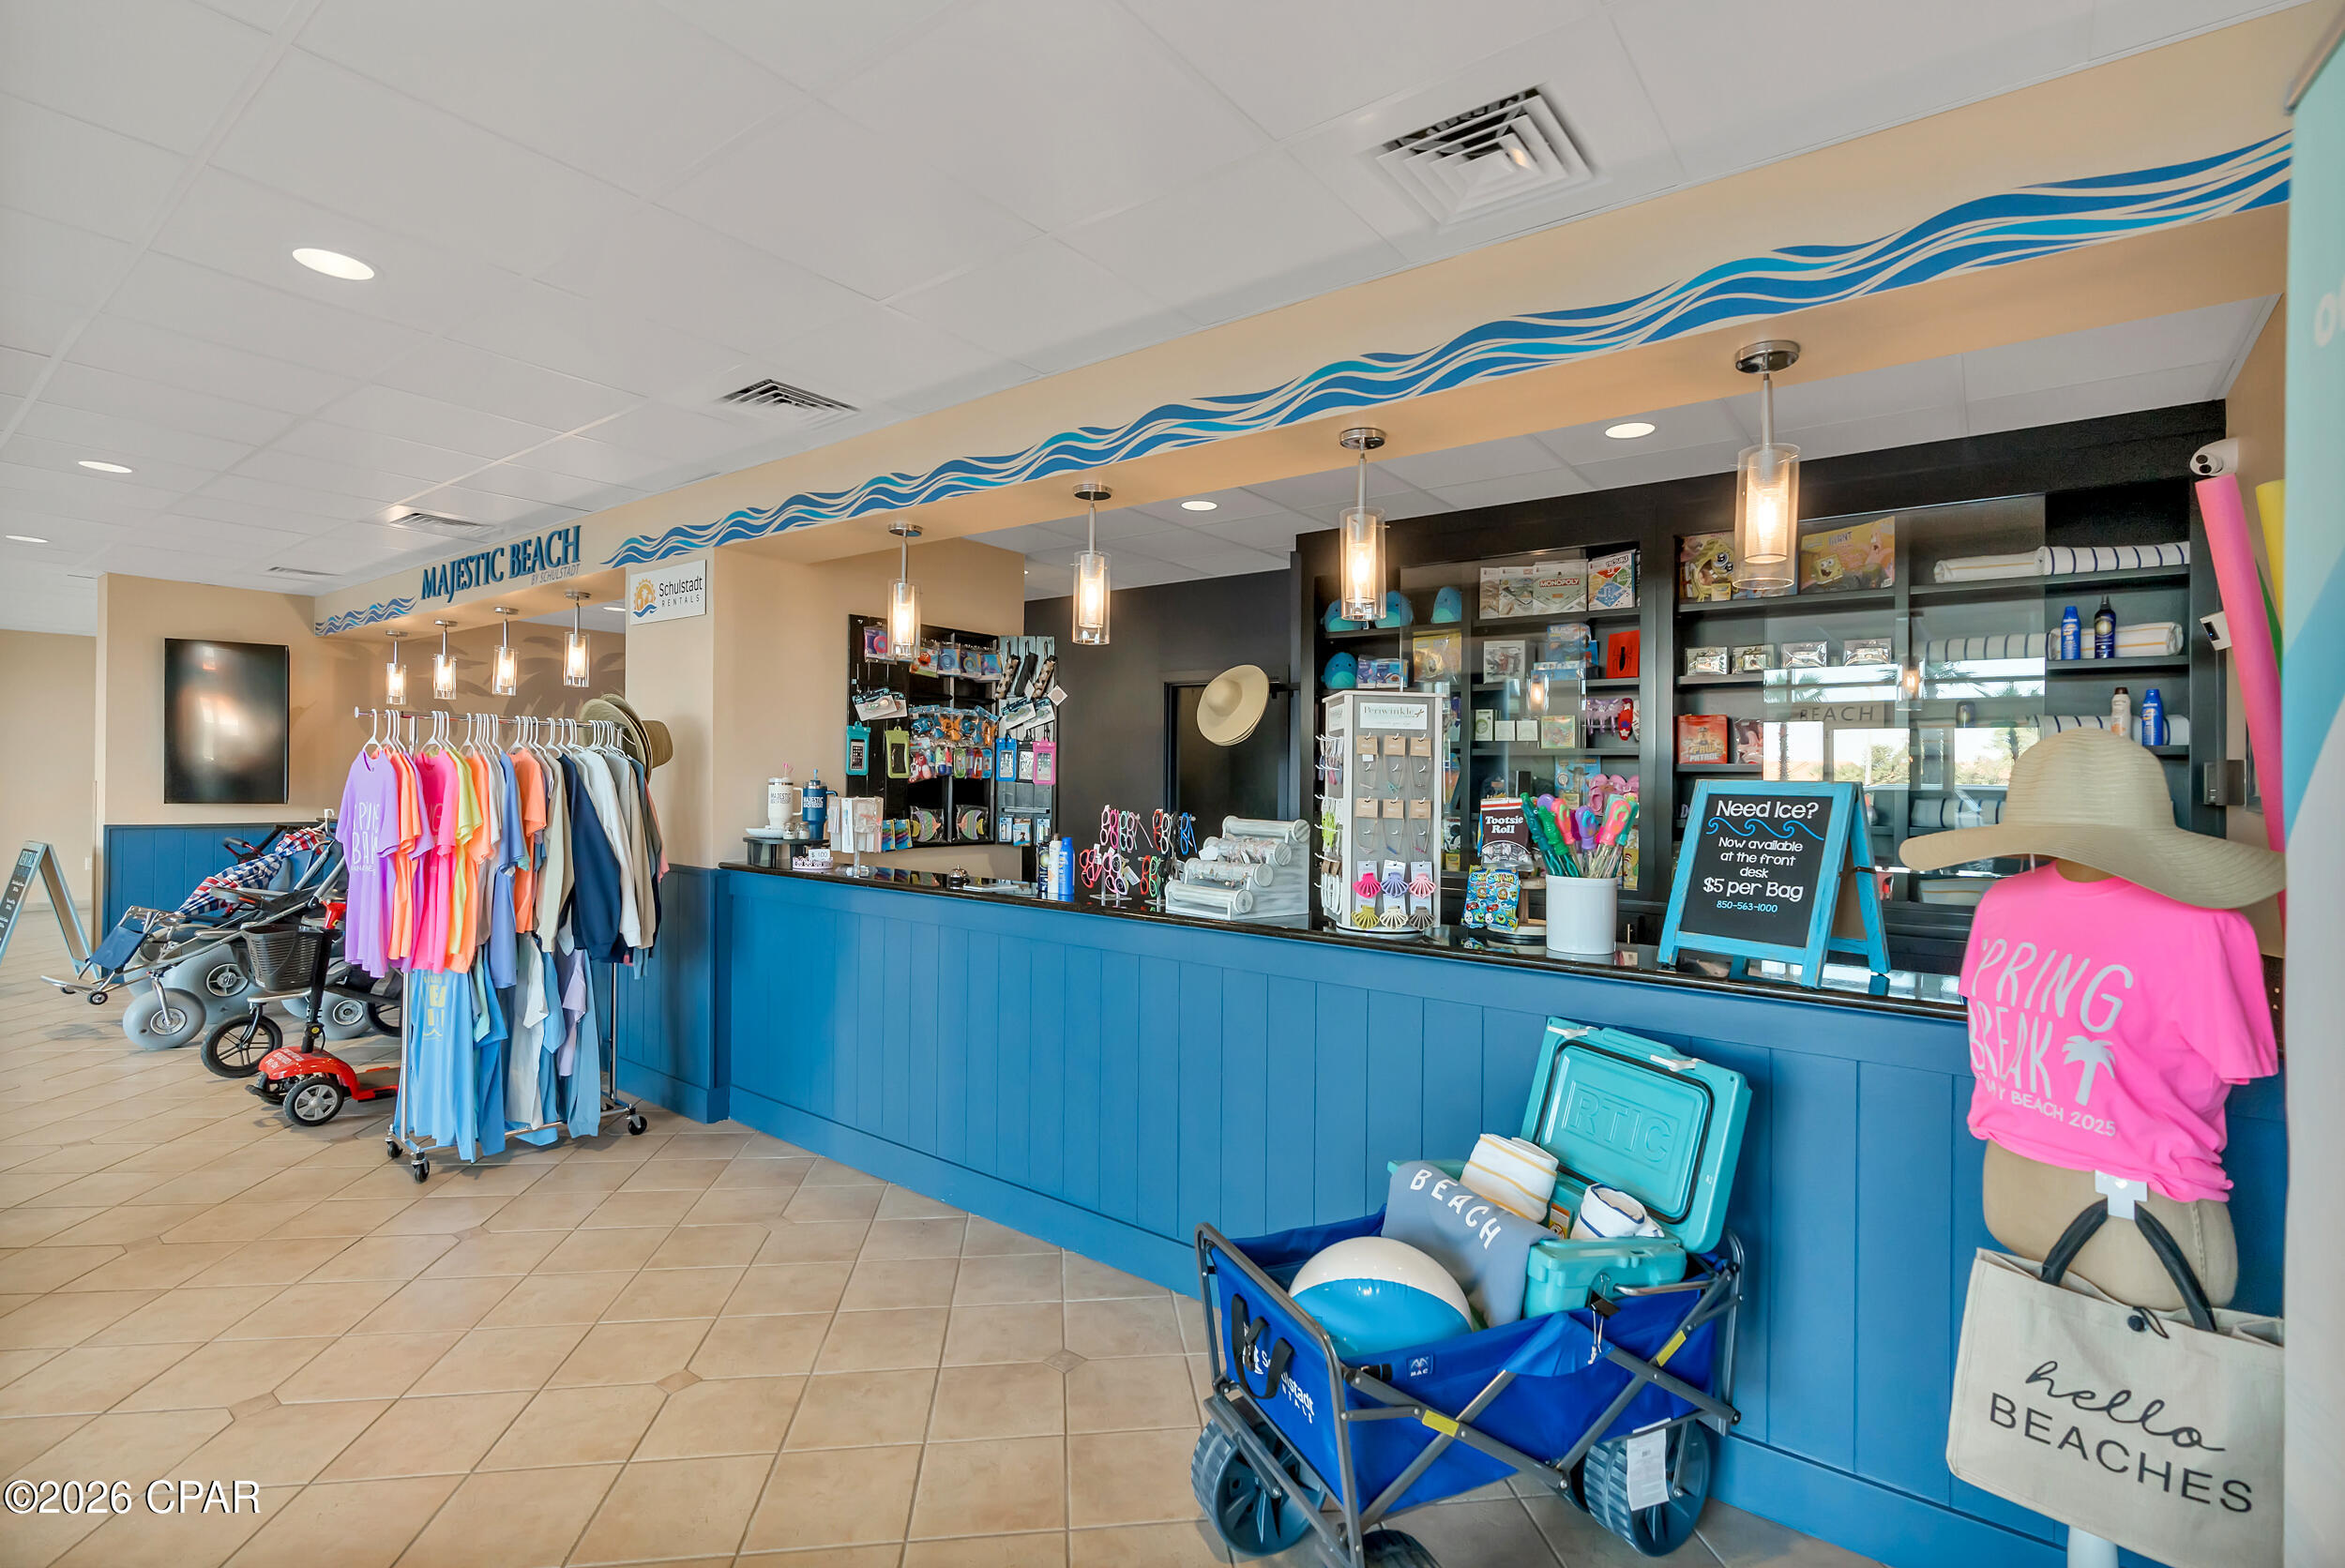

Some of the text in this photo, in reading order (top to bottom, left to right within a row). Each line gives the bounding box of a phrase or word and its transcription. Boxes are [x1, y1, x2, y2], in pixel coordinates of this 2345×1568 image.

[421, 524, 582, 603] MAJESTIC BEACH
[531, 564, 581, 586] BY SCHULSTADT
[1538, 577, 1580, 588] MONOPOLY
[658, 576, 703, 598] Schulstadt
[661, 593, 701, 608] RENTALS
[1485, 815, 1524, 824] Tootsie
[1716, 800, 1819, 820] Need Ice?
[1491, 824, 1516, 834] Roll
[1718, 837, 1803, 852] Now available
[1720, 852, 1796, 867] at the front
[1739, 867, 1769, 879] desk
[1702, 877, 1804, 902] $5 per Bag
[1716, 900, 1778, 913] 850-563-1000
[1972, 938, 2133, 1033] PRING
[2011, 1091, 2116, 1137] BEACH 2025
[1569, 1087, 1672, 1163] RTIC
[1410, 1168, 1501, 1250] BEACH
[1410, 1367, 1429, 1377] MAC
[2025, 1360, 2226, 1453] hello
[1989, 1392, 2254, 1514] BEACHES
